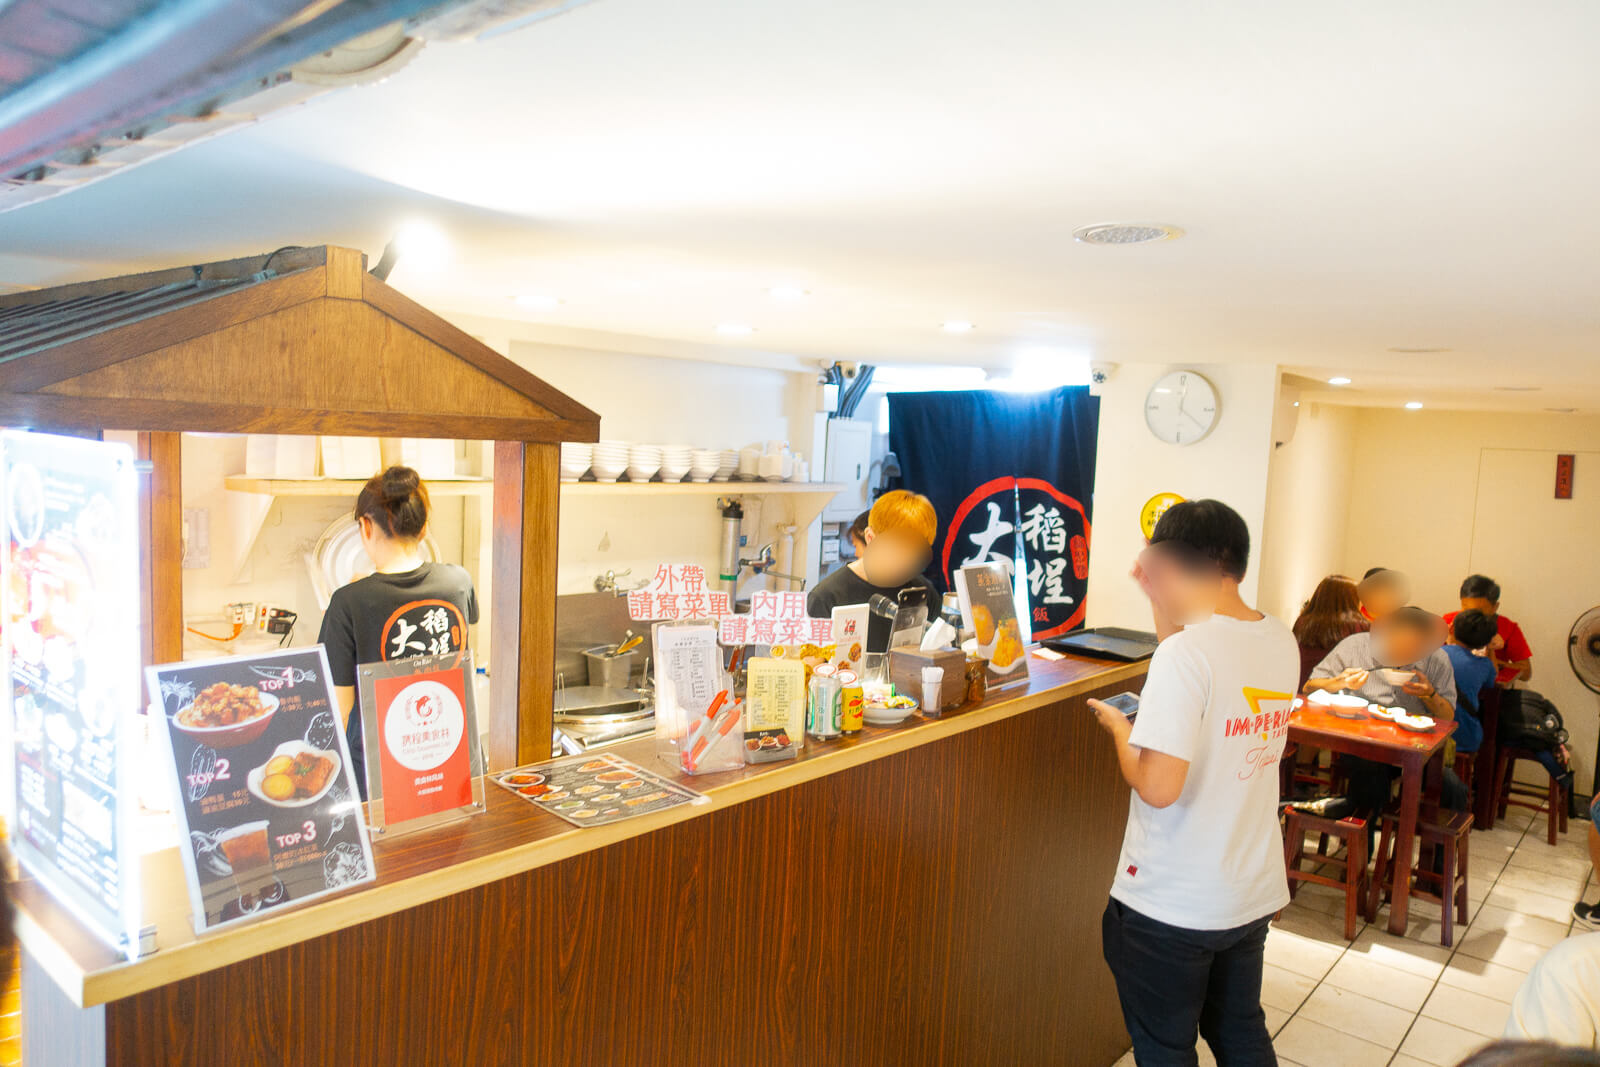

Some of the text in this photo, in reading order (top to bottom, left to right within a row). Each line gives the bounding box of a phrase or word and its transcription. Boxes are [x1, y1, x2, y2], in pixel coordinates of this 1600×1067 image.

[962, 501, 1015, 576] 大
[1021, 503, 1074, 605] 稻埕
[654, 564, 705, 593] 外帶
[629, 591, 731, 620] 請寫菜單
[752, 592, 806, 618] 內用
[1033, 606, 1049, 622] 飯
[390, 618, 427, 658] 大
[722, 616, 834, 646] 請寫菜單
